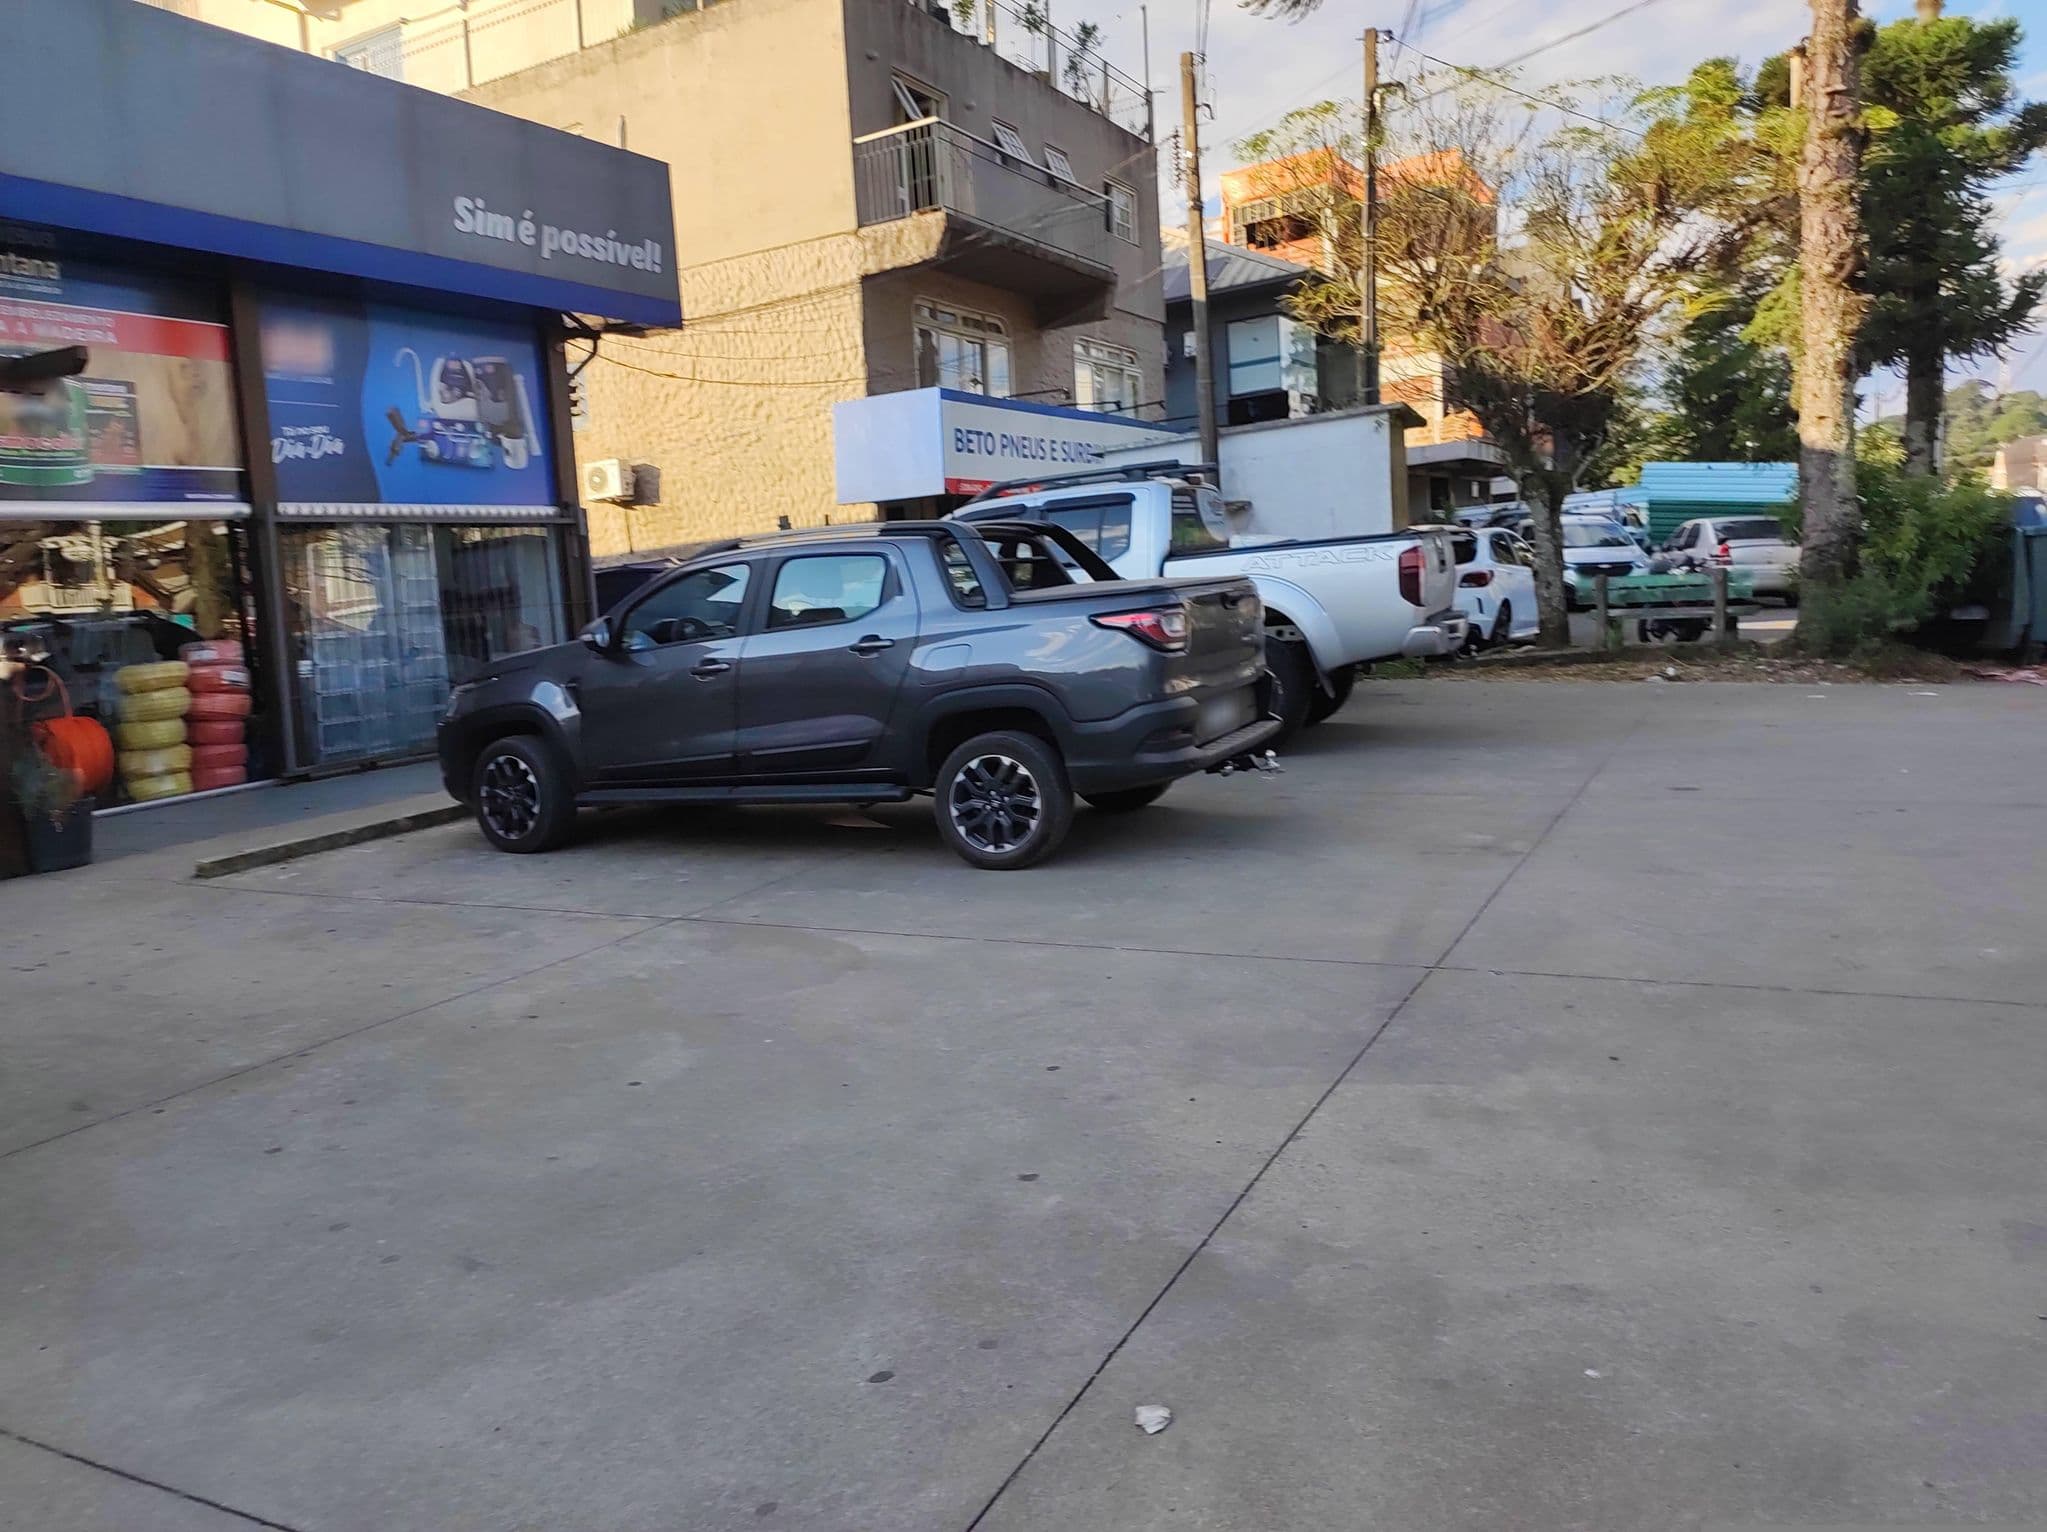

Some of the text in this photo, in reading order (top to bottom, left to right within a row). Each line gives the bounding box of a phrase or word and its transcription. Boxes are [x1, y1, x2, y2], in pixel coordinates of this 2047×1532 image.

[453, 195, 662, 274] Sim é possível!
[954, 428, 996, 456] BETO
[1000, 433, 1047, 461] PNEUS
[1050, 439, 1059, 462] E
[1241, 545, 1395, 572] ATTACK
